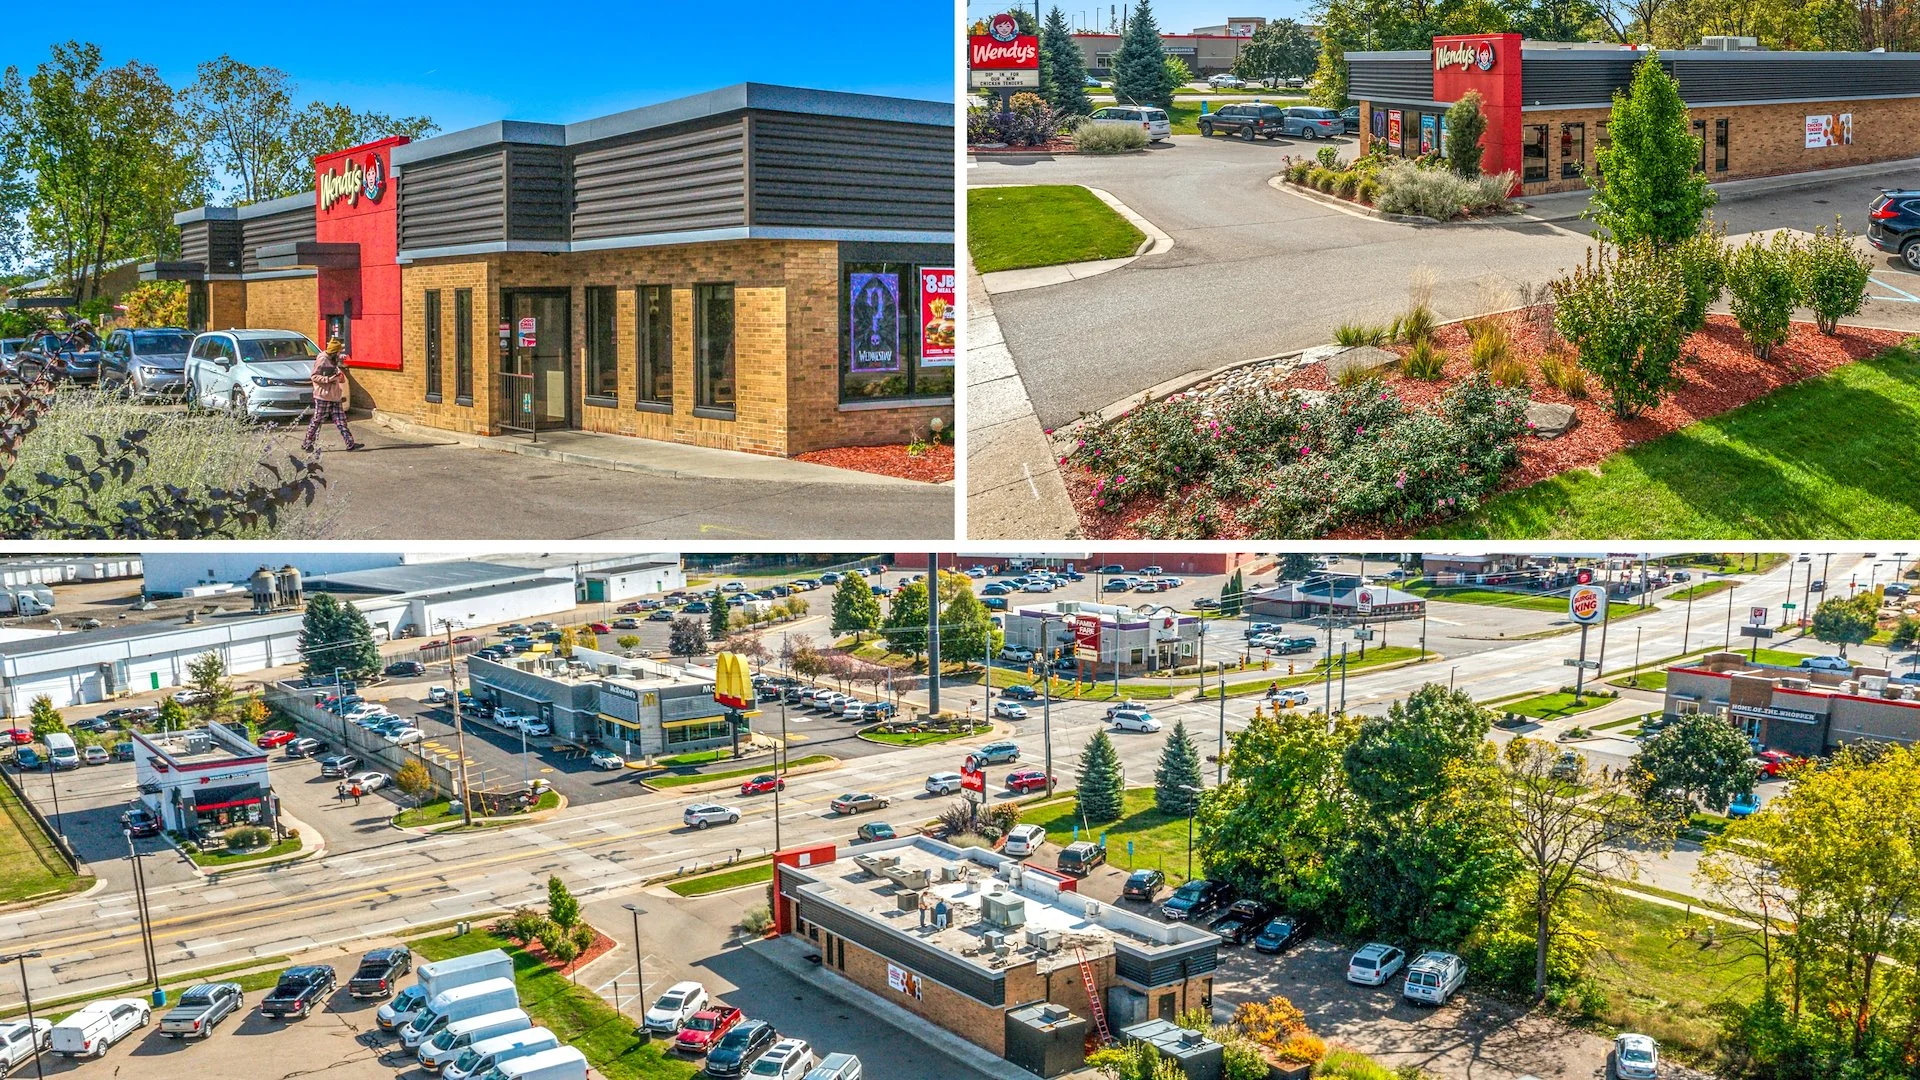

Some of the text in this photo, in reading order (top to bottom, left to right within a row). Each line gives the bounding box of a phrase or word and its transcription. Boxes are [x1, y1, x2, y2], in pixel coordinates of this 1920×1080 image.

[973, 40, 1036, 64] Wendy's
[1435, 41, 1476, 71] Wendy's
[320, 158, 363, 211] Wendy's
[1574, 593, 1597, 604] BURGER
[1574, 600, 1597, 612] KING
[1076, 619, 1097, 628] FAMILY
[1079, 626, 1095, 635] FARE
[609, 684, 637, 699] McDonald's
[1732, 703, 1752, 712] HOME
[1780, 710, 1815, 720] WHOPPER
